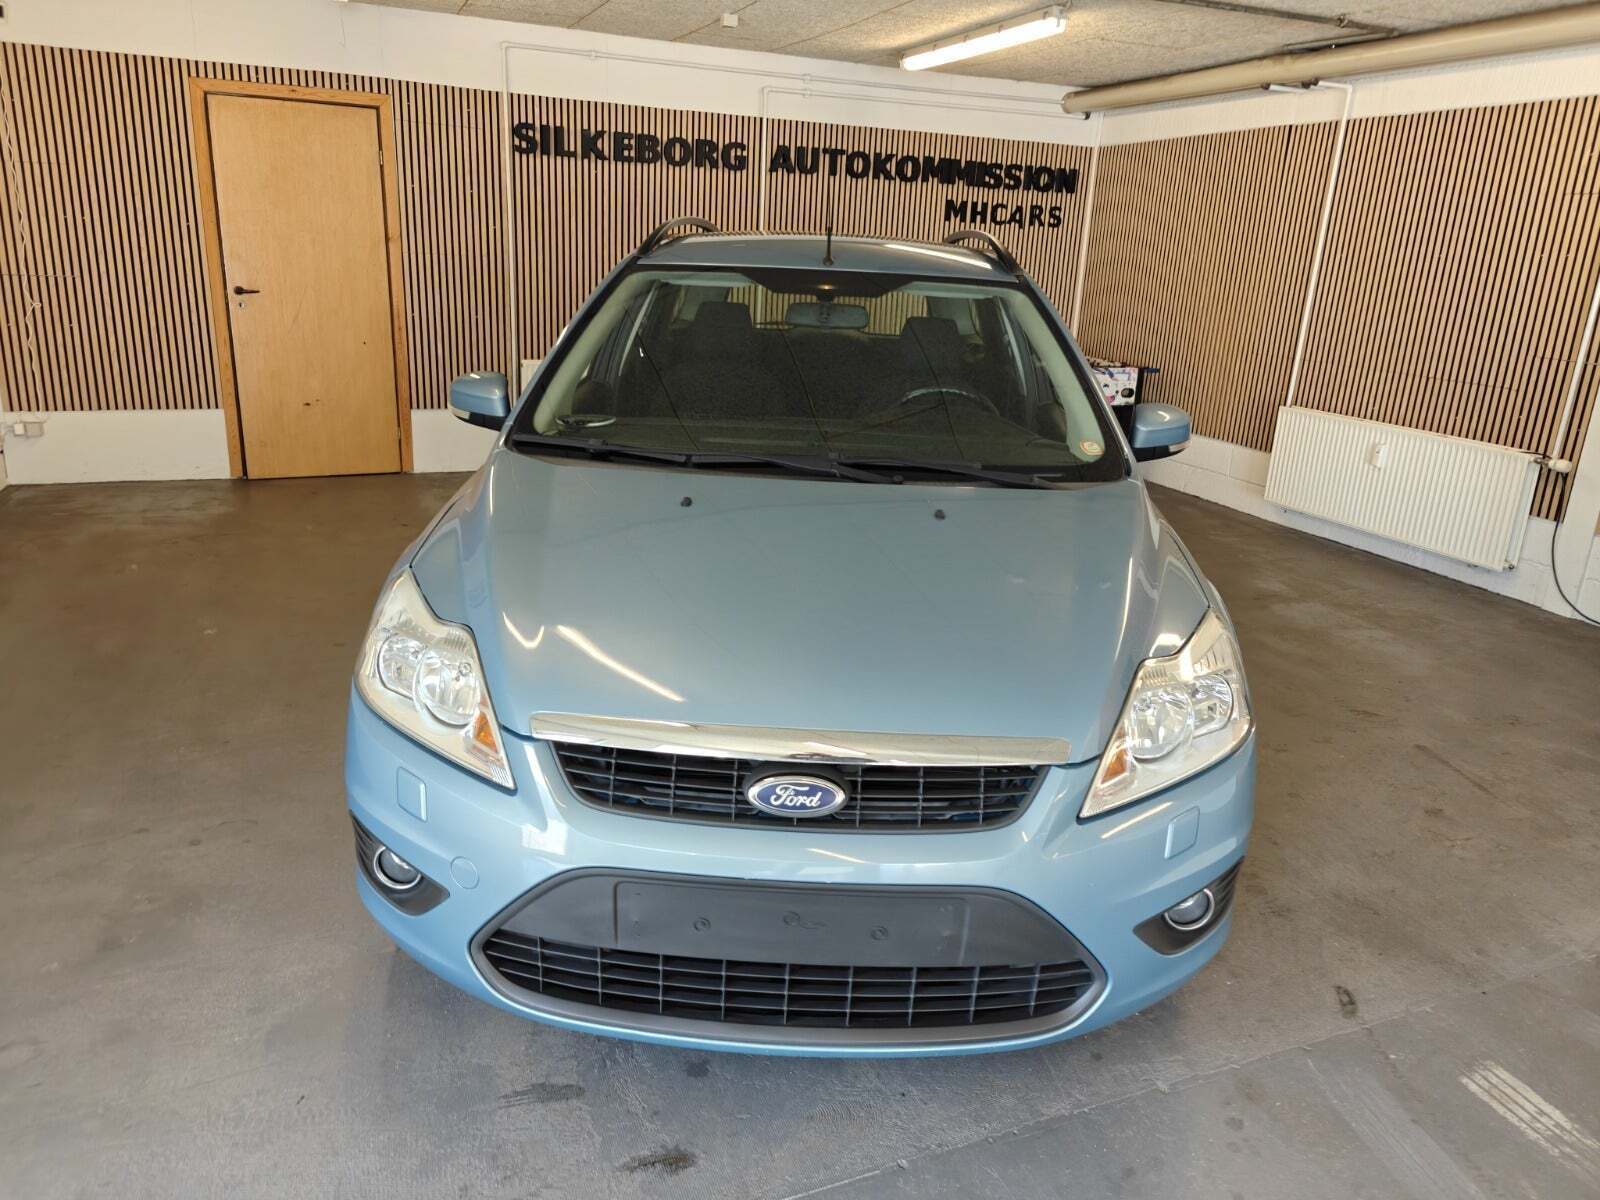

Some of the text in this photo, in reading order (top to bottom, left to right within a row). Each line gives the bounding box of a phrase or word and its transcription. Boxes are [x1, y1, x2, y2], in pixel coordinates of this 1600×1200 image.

[512, 122, 1078, 194] SILKEBORG AUTOKOMMISSION
[944, 199, 1062, 229] MHCARS
[770, 784, 822, 807] Ford
